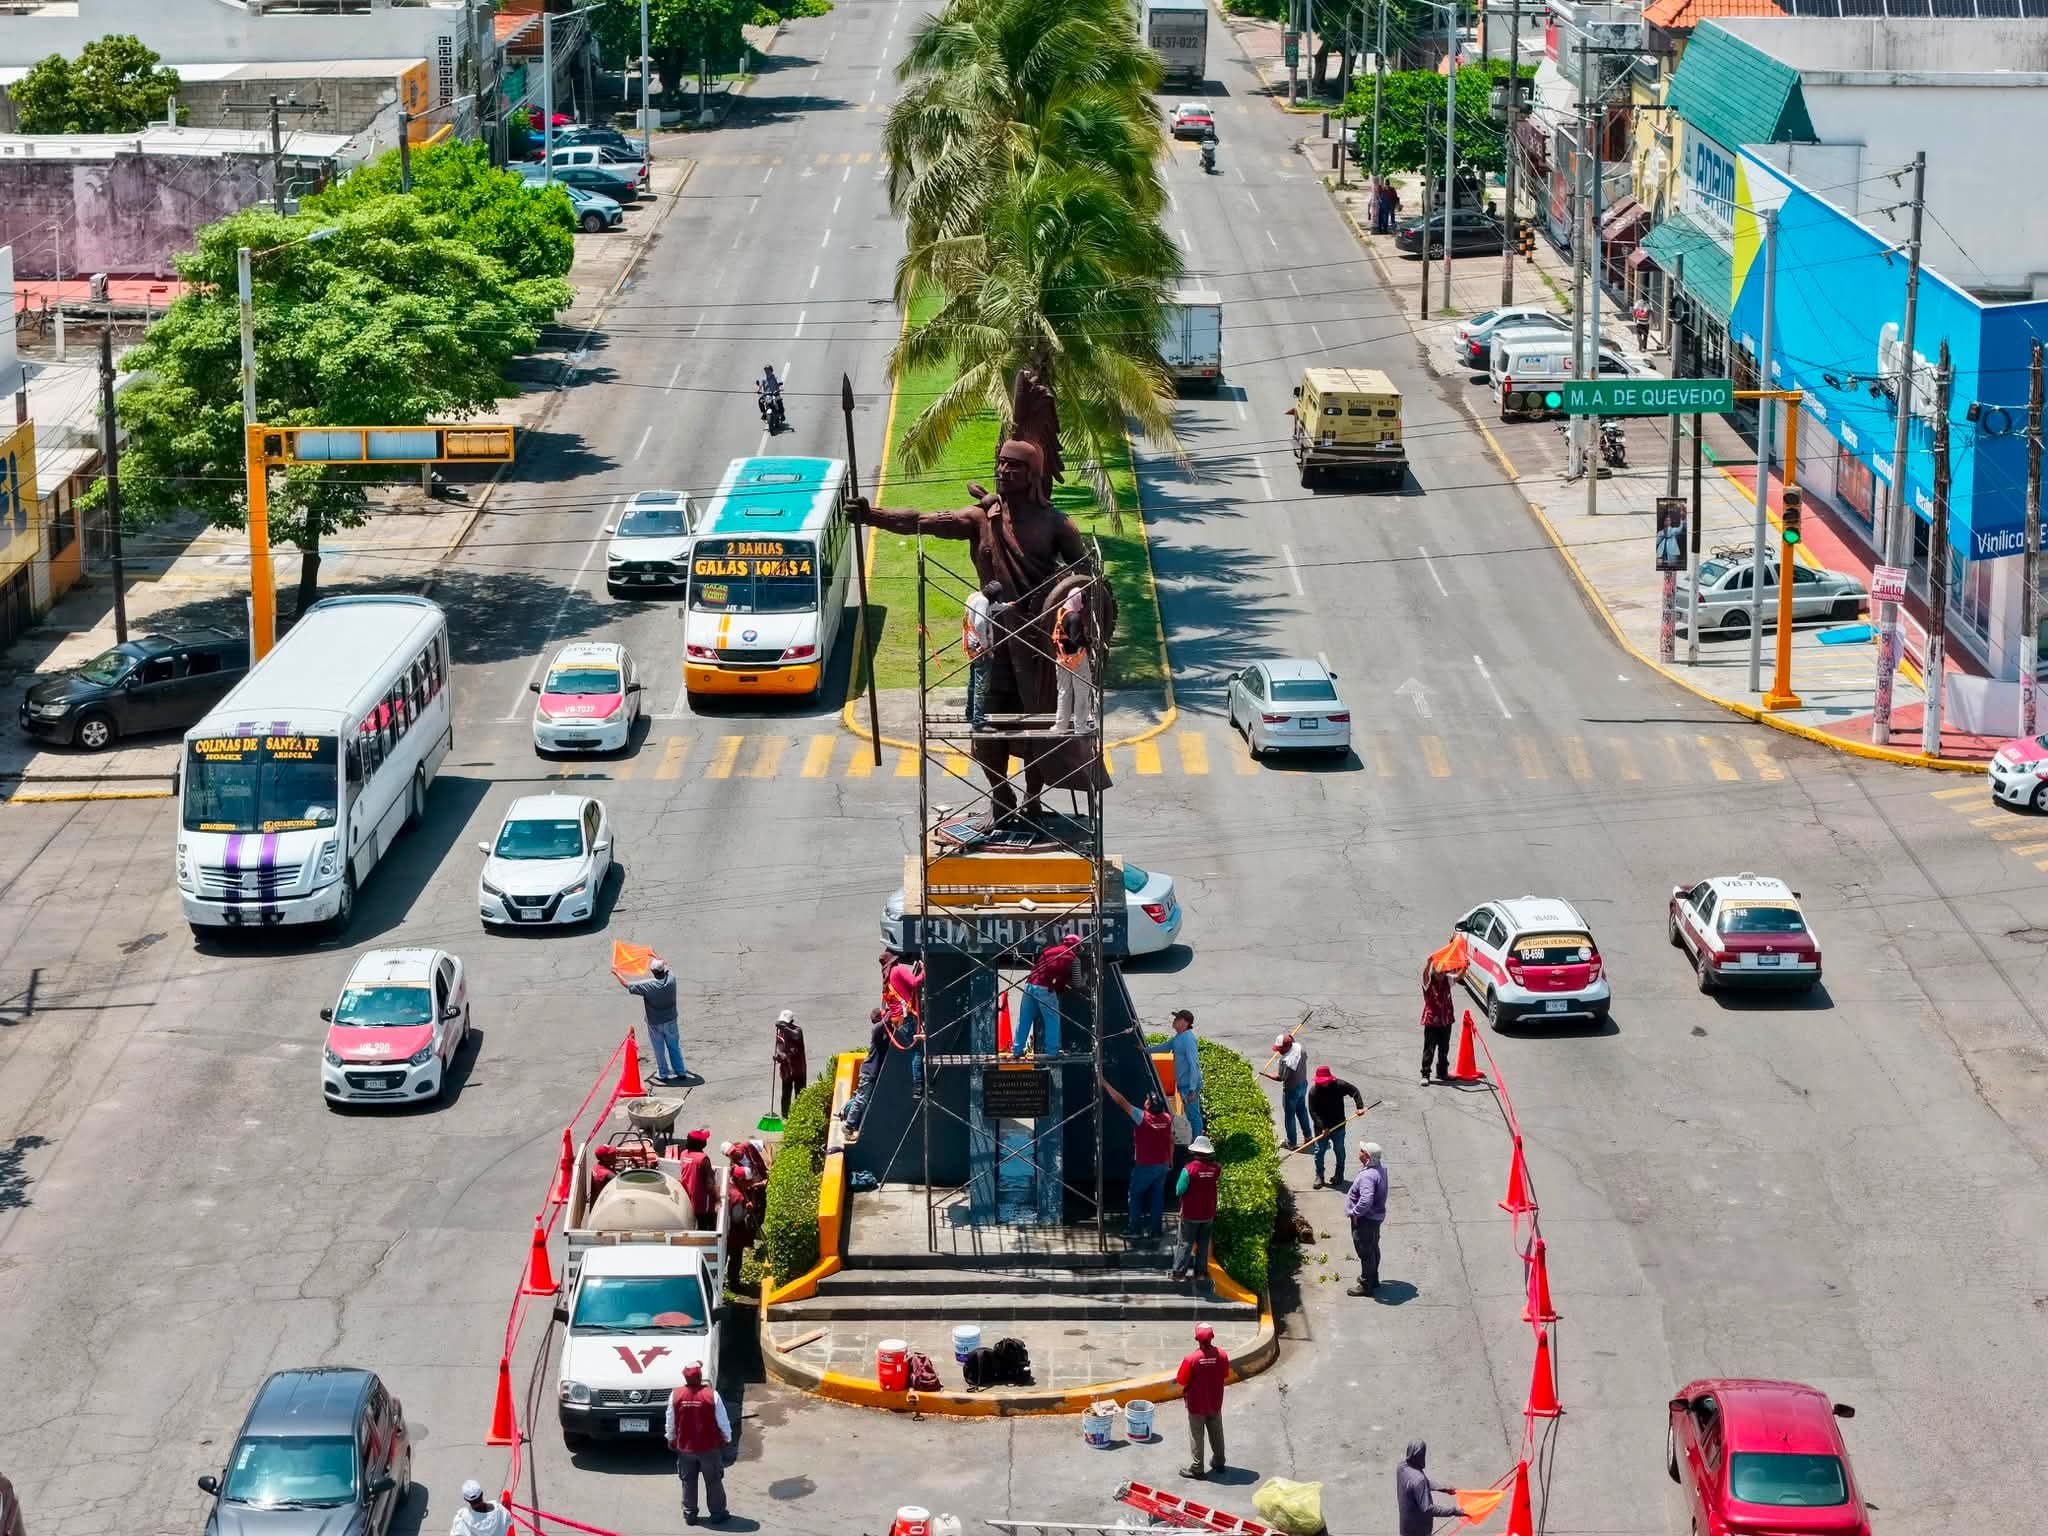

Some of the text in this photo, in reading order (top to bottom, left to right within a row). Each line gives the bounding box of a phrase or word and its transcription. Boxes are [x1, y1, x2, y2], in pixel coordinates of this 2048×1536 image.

[1571, 388, 1726, 406] M. A. DE QUEVEDO
[1977, 529, 2025, 554] Vinílica
[728, 542, 784, 555] 2 BAHIAS
[695, 560, 748, 576] GALAS
[800, 560, 811, 576] 4
[1880, 583, 1902, 595] auto
[196, 737, 319, 752] COLINAS DE SANTA FE
[1722, 880, 1779, 888] VB-7165
[1524, 937, 1584, 947] REGION VERACRUZ
[1520, 949, 1545, 960] VB-6560
